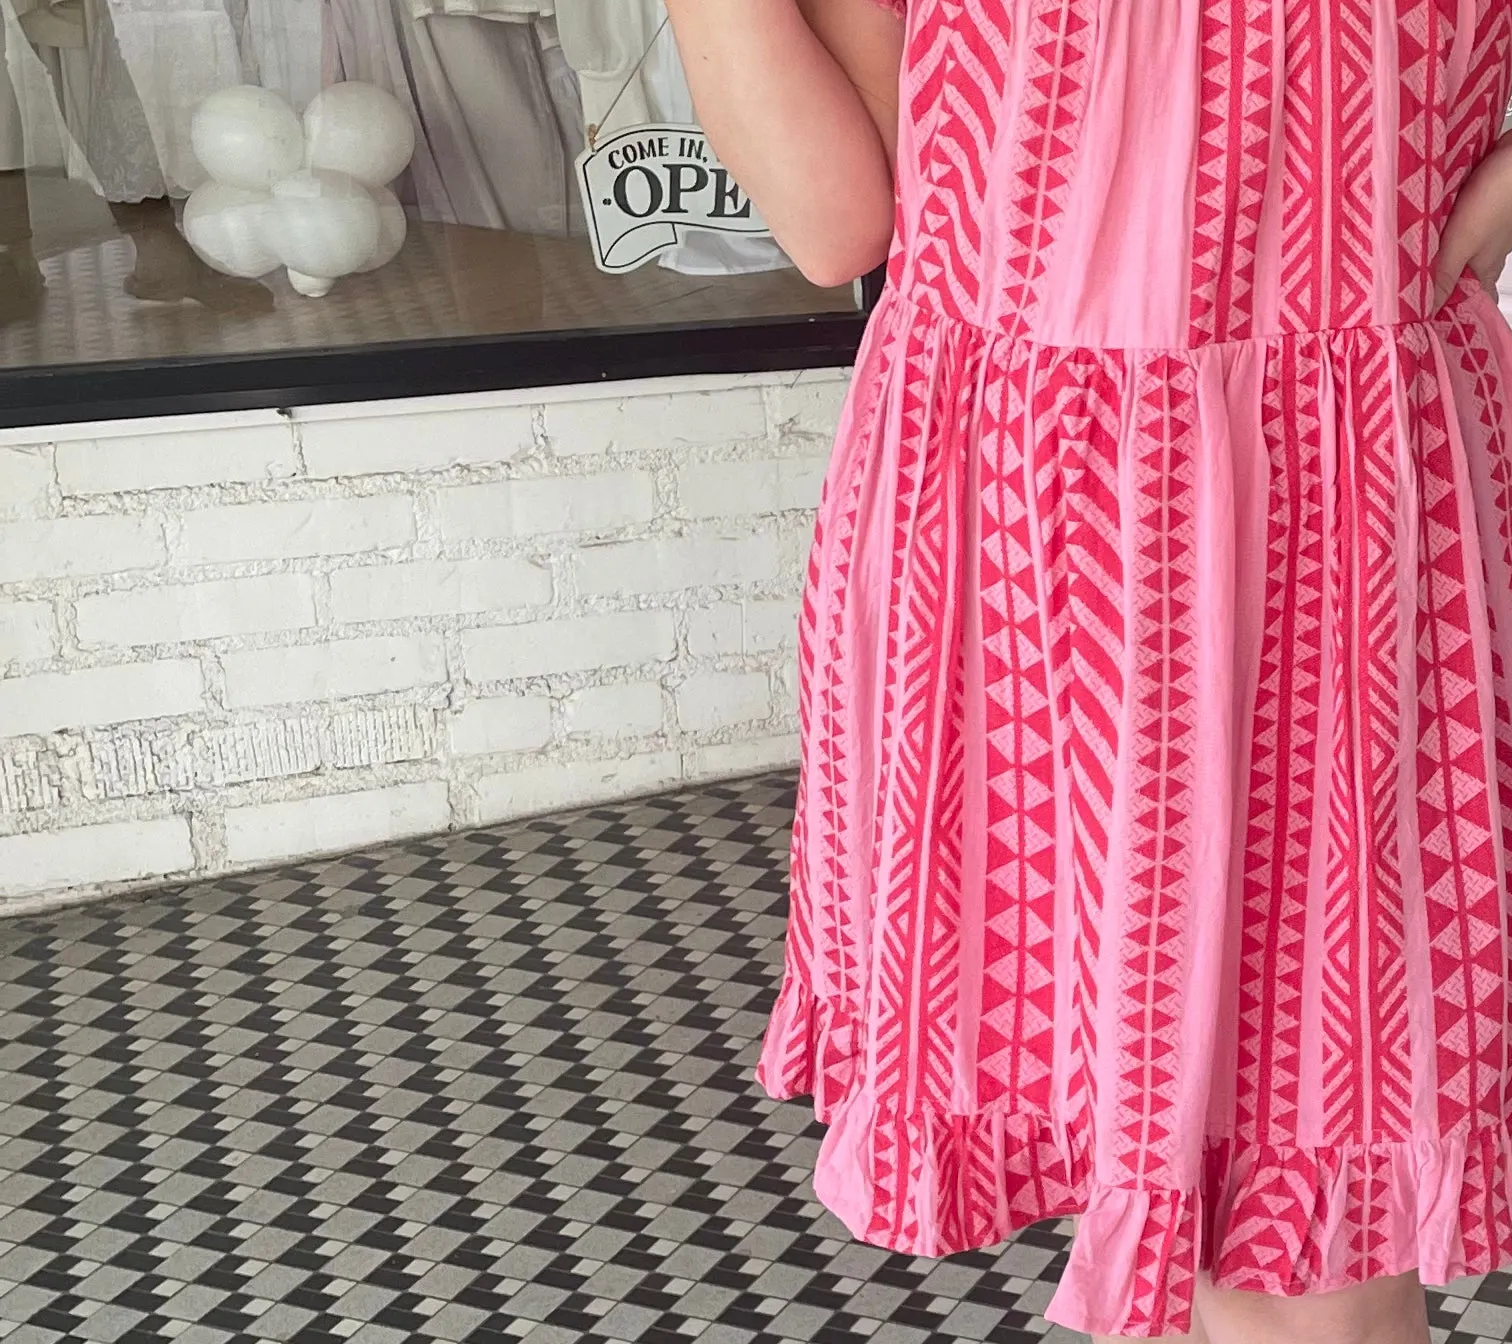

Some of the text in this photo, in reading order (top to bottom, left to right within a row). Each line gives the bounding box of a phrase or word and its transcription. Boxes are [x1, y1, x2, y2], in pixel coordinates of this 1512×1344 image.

[608, 137, 708, 169] COME IN,
[613, 163, 750, 218] OPE
